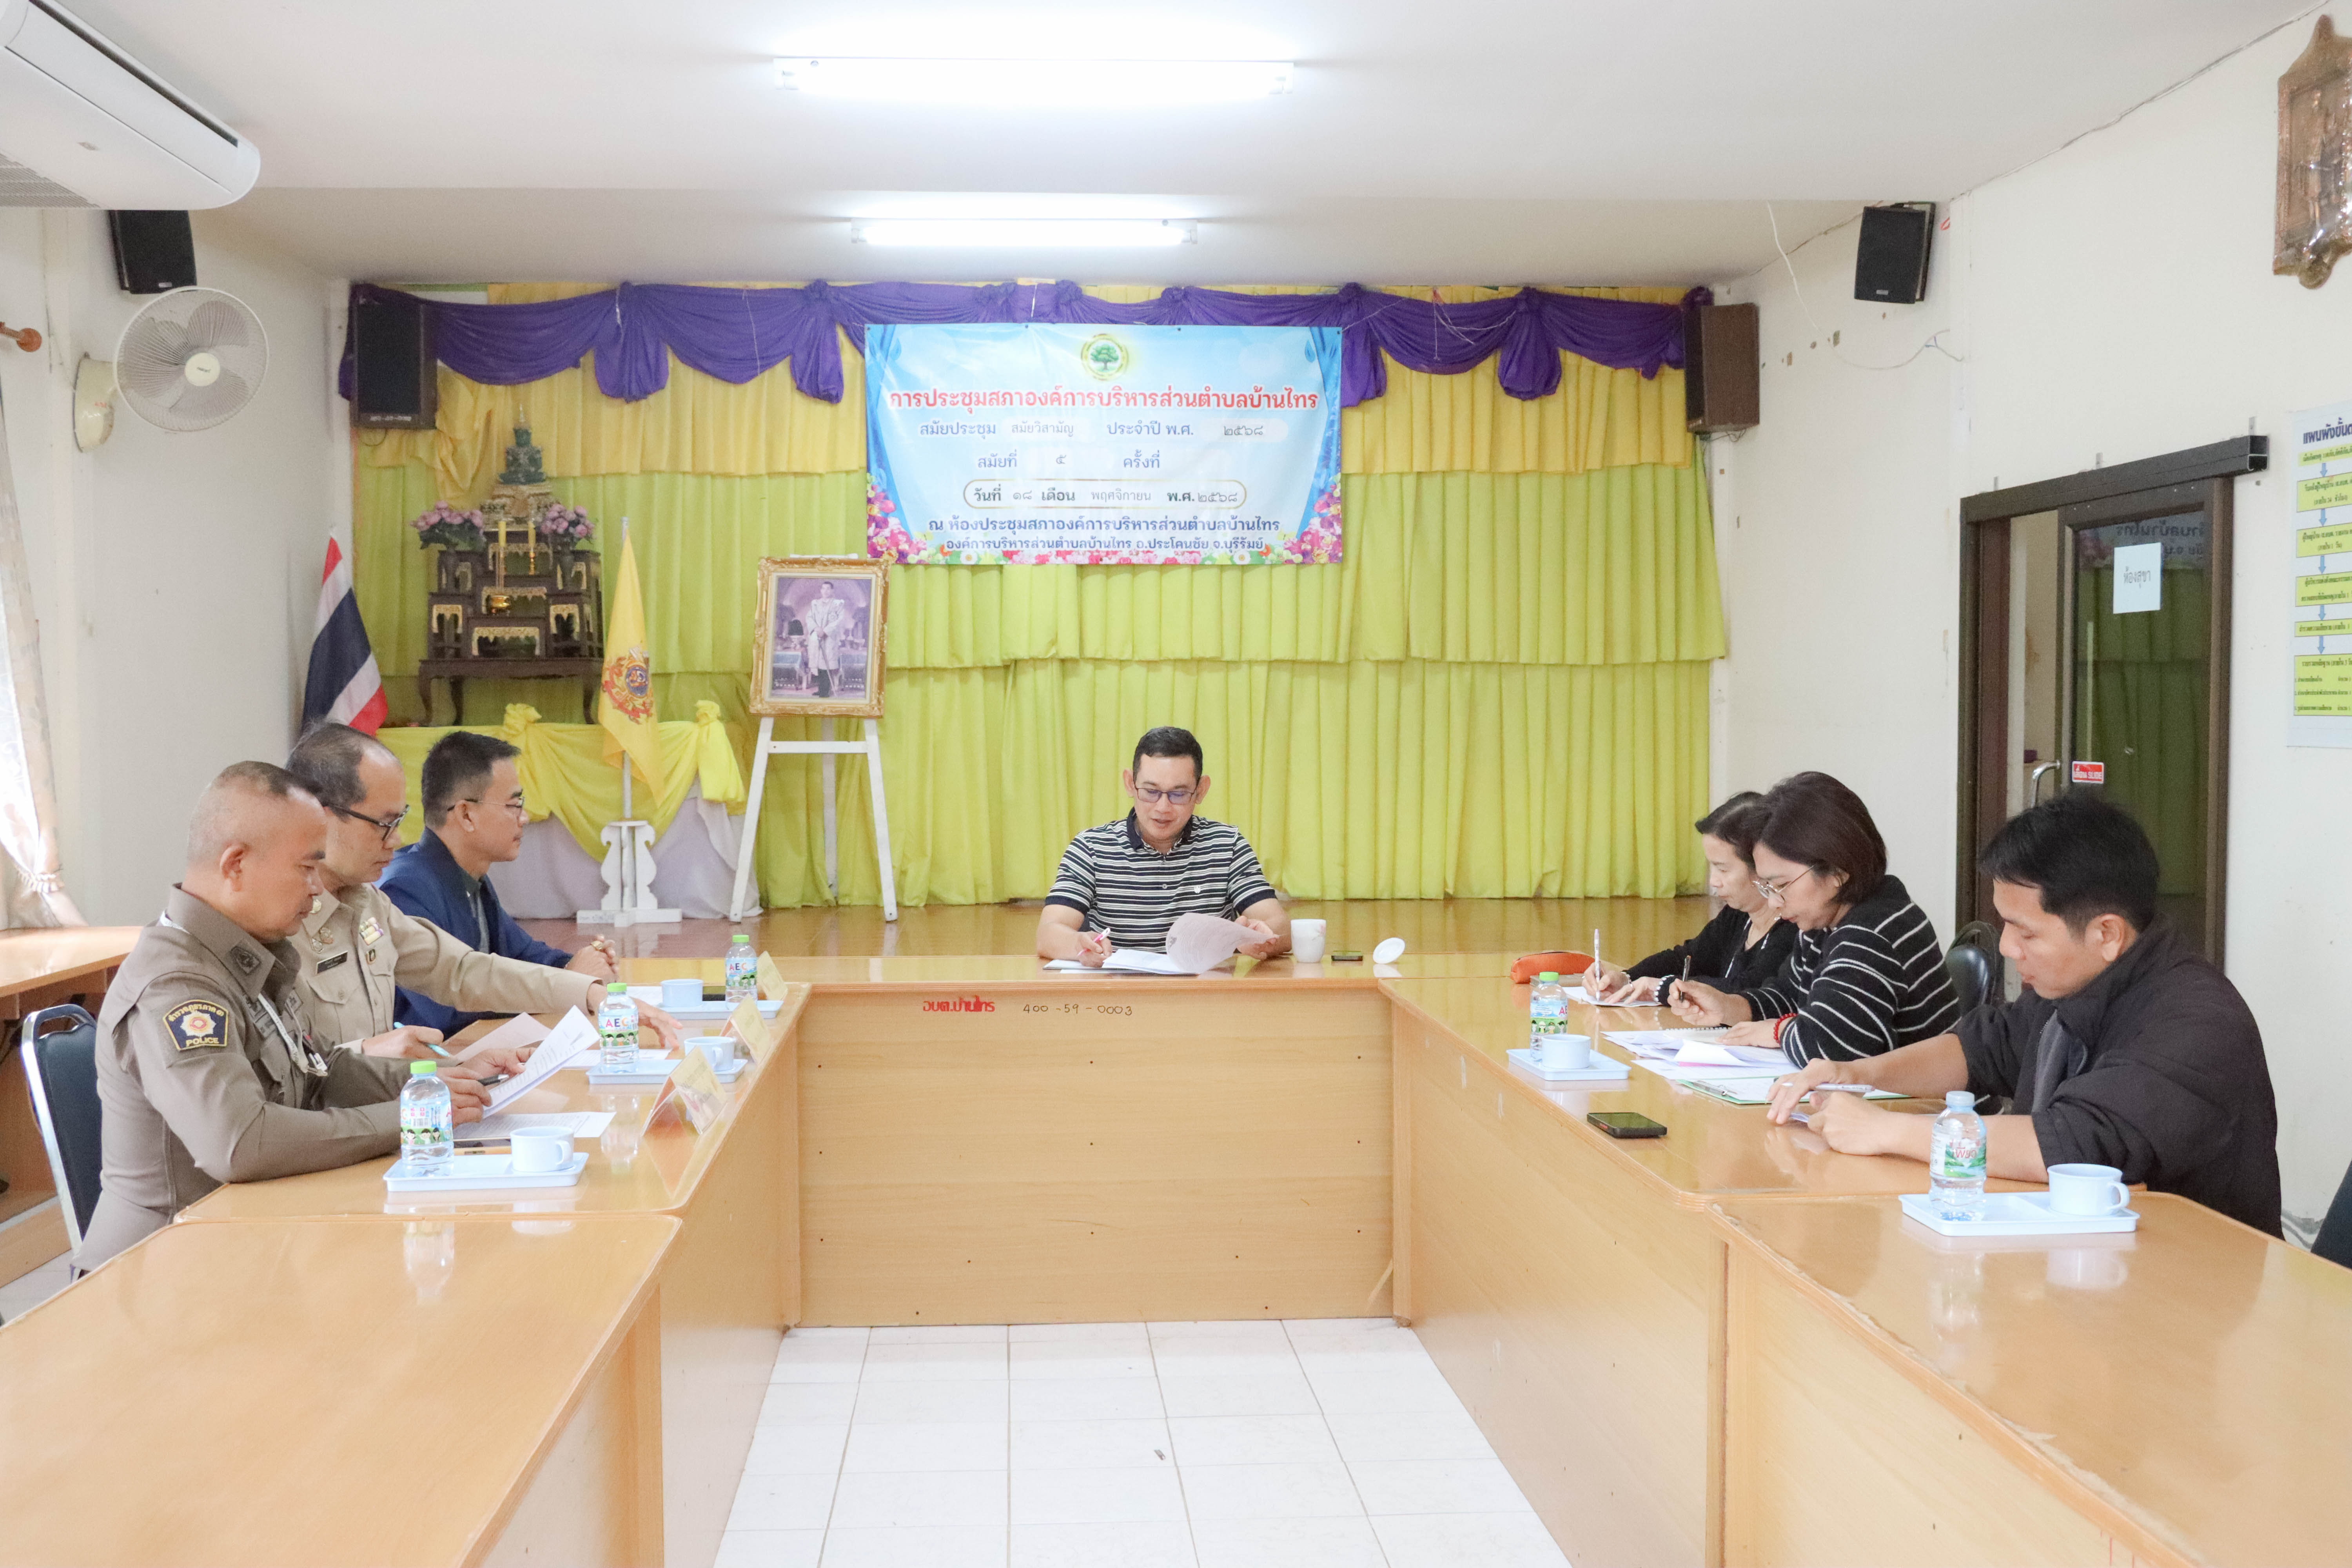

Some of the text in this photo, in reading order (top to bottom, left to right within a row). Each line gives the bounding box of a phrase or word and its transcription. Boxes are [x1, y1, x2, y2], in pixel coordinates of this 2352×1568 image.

[890, 385, 1318, 414] การประชุมสภาองค์การบริหารส่วนตำบลบ้านไทร
[920, 419, 1263, 439] สมัยประชุม สมัยวิสามัญ ประจำปี พ.ศ. ๒๕๖๘
[978, 449, 1160, 468] สมัยที่ ๕ ครั้งที่
[974, 484, 1238, 502] วันที่ ๑๘ เดือน พฤศจิกายน พ.ศ. ๒๕๖๘
[929, 514, 1279, 535] ณ ห้องประชุมสภาองค์การบริหารส่วนตำบลบ้านไทร
[946, 536, 1263, 553] องค์การบริหารส่วนตำบลบ้านไทร อ.ประโคนชัย จ.บุรีรัมย์
[2123, 566, 2151, 588] ห้องสุขา
[729, 962, 747, 971] AEC
[606, 1017, 628, 1027] AEC
[185, 1037, 220, 1047] POLICE
